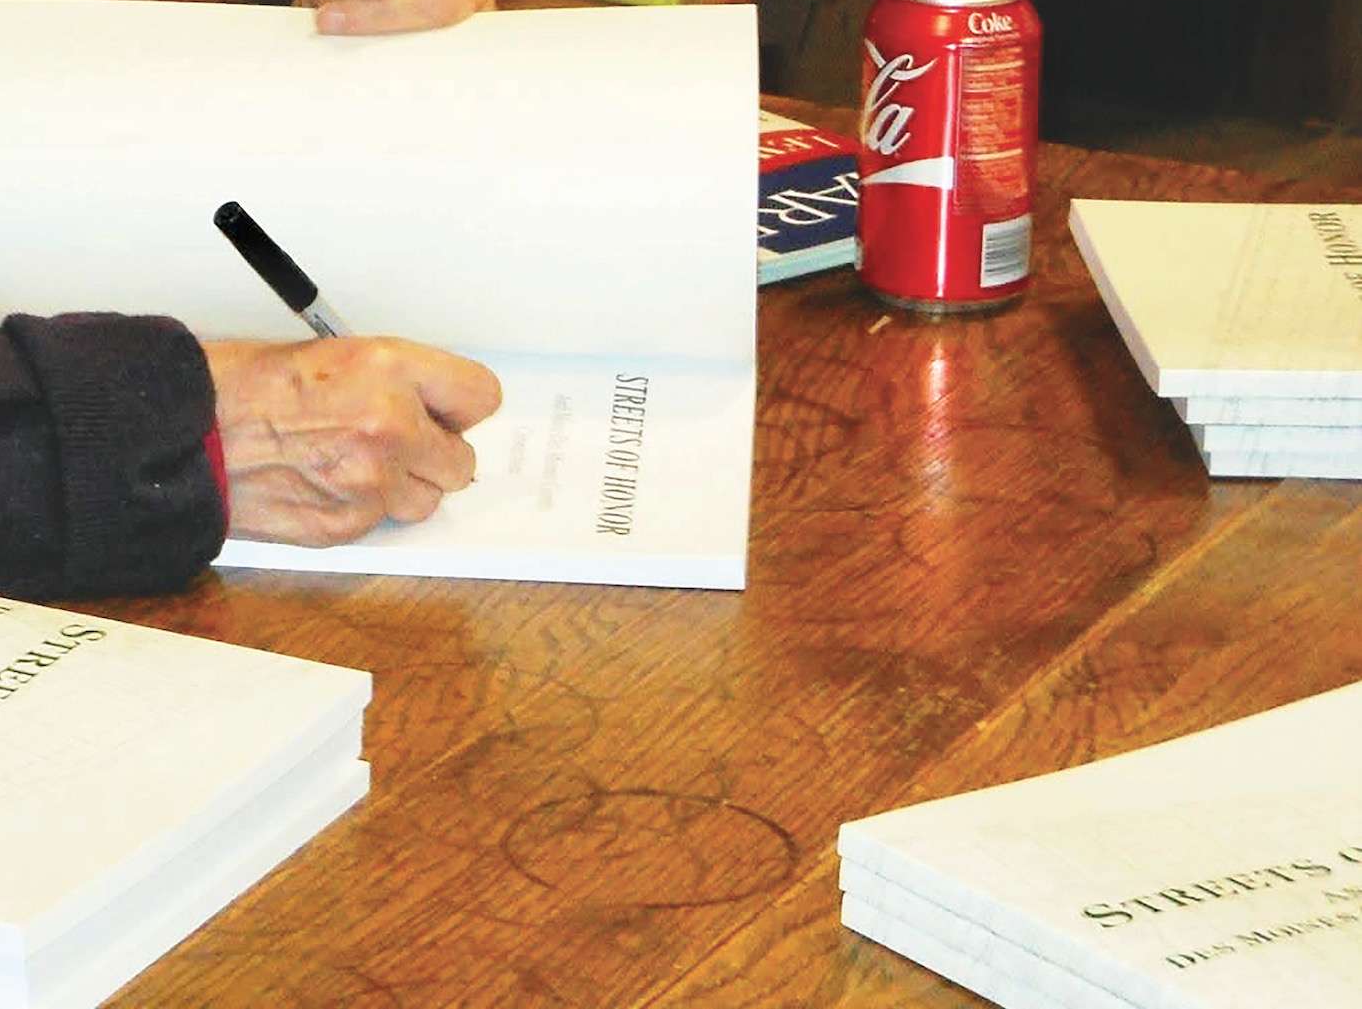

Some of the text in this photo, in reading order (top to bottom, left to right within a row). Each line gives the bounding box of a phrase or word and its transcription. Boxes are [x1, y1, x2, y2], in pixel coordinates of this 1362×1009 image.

[968, 12, 1014, 35] Coke
[596, 373, 649, 535] STREETS OF HONOR
[1083, 846, 1362, 928] STREETS O
[1165, 913, 1359, 969] DES MOINES
